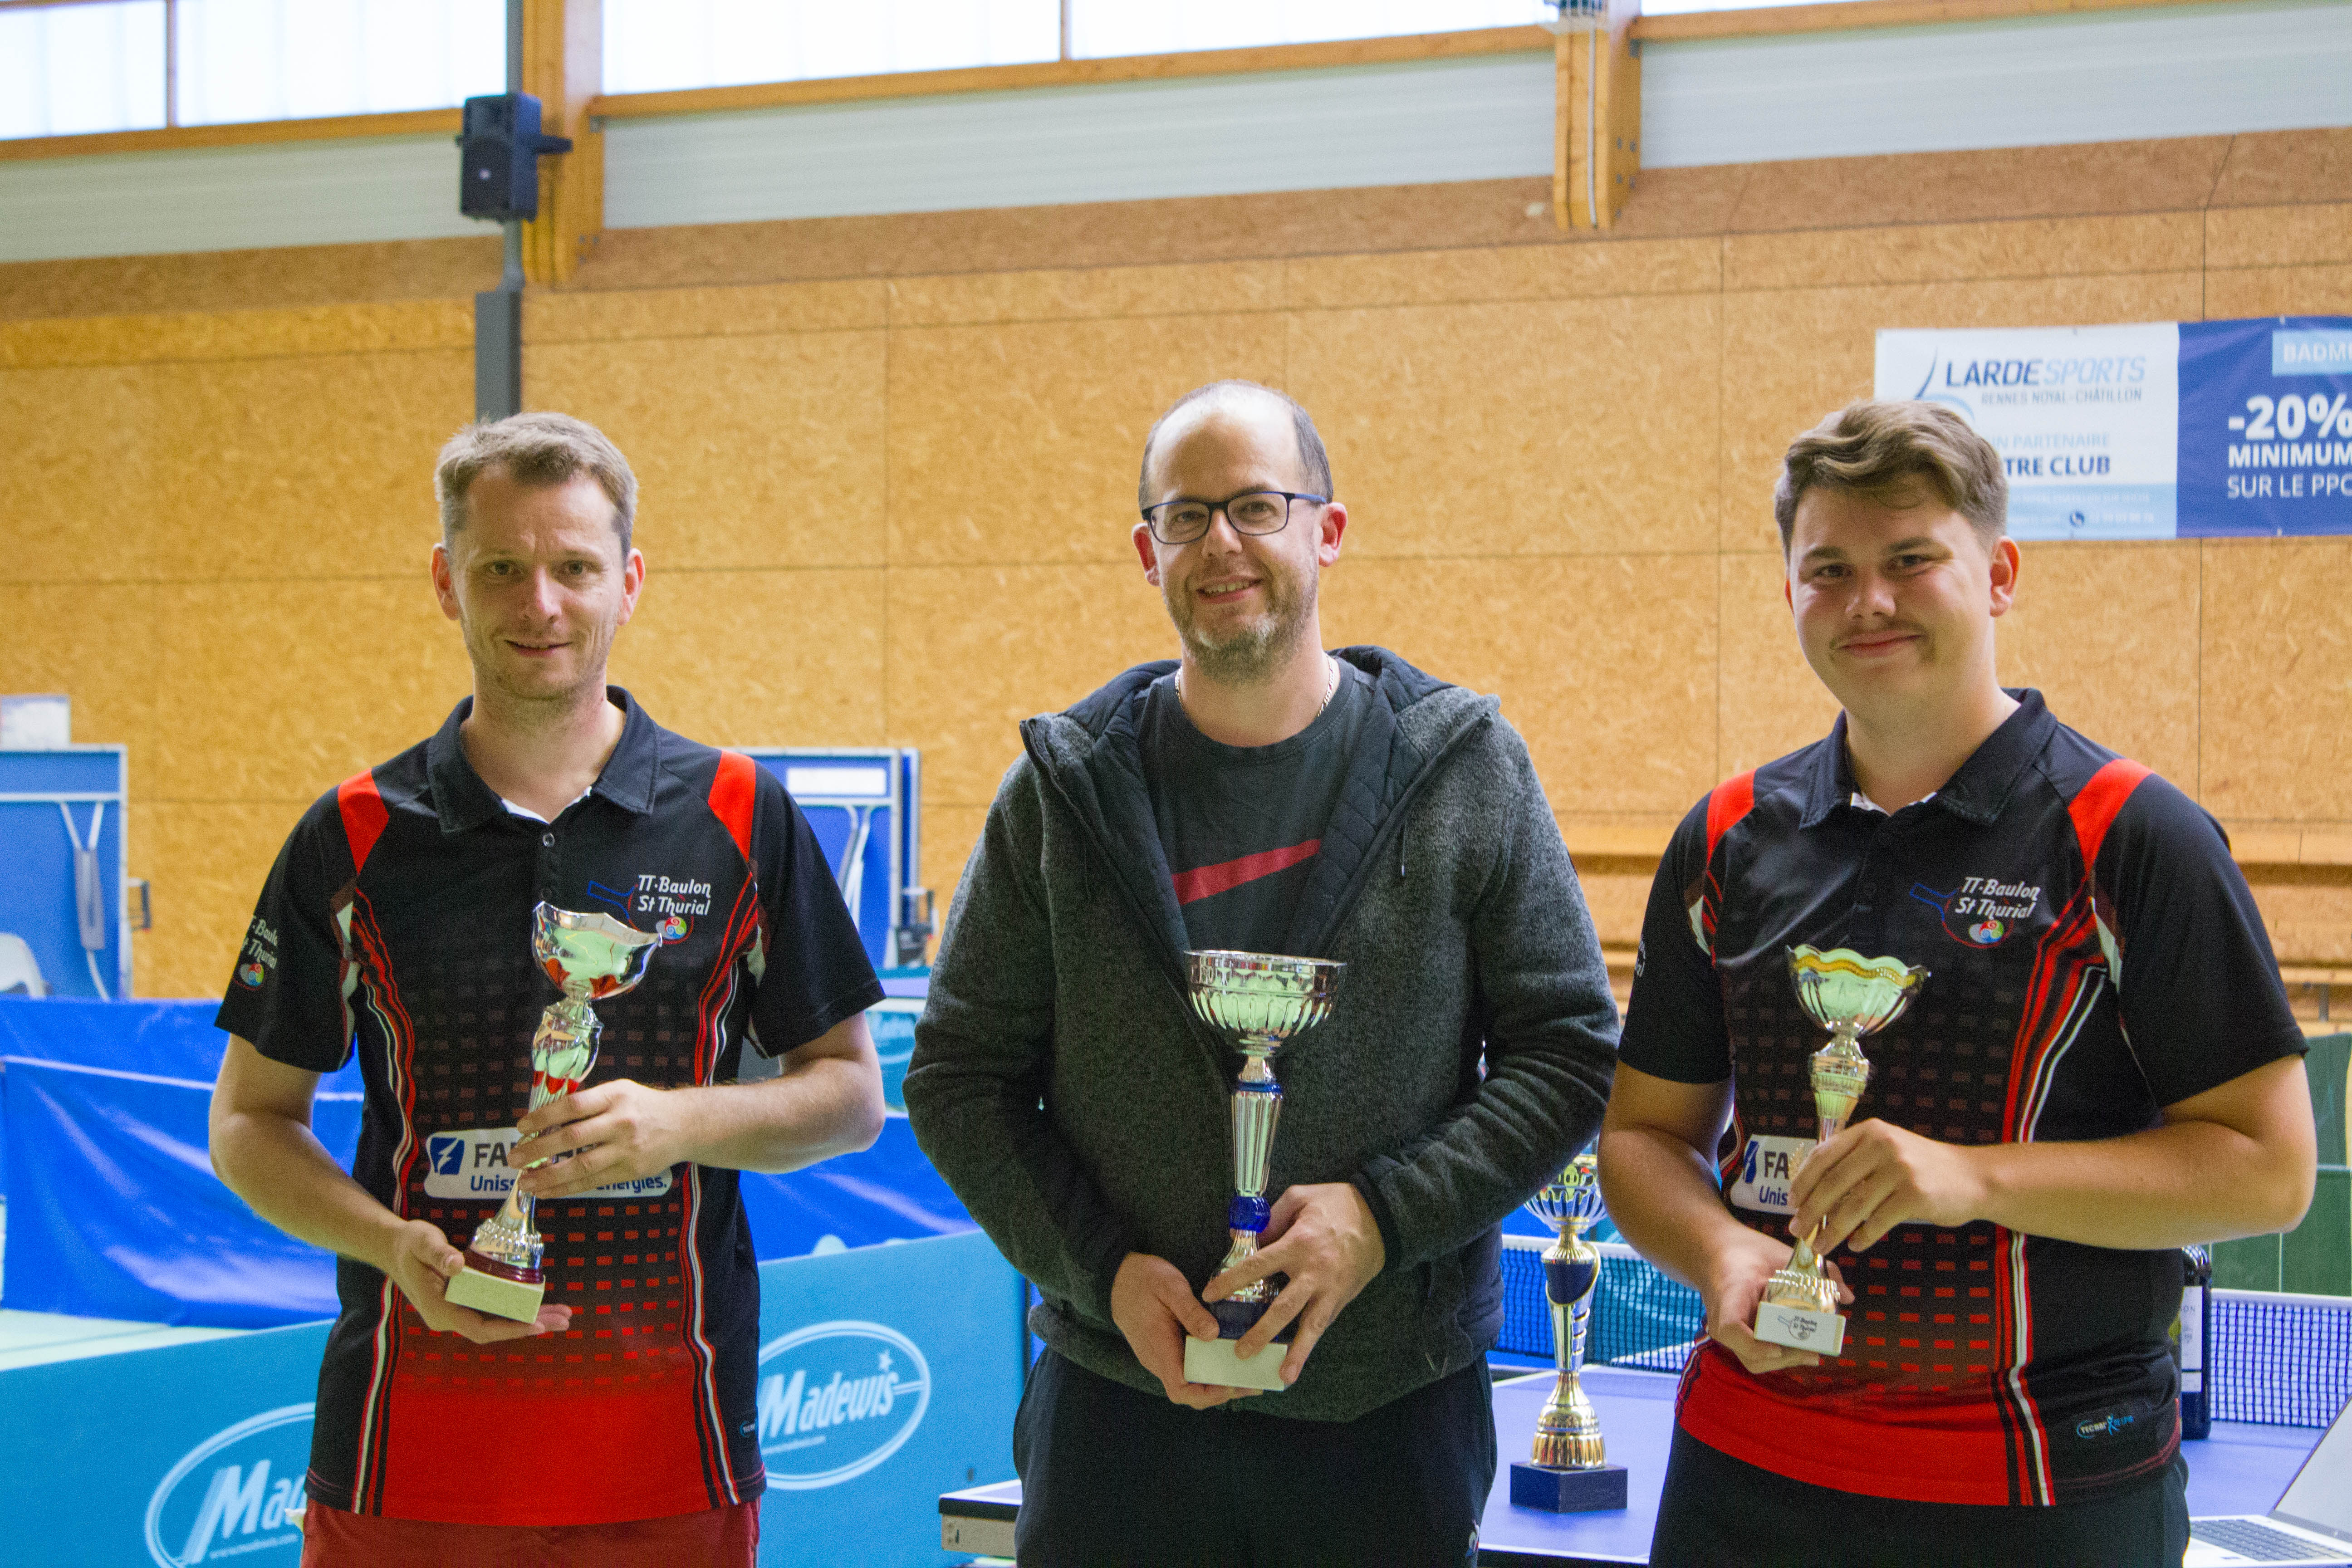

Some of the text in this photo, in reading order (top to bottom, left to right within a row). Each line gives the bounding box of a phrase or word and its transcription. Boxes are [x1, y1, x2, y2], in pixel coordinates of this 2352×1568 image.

[2229, 394, 2352, 440] -20%
[2013, 433, 2109, 449] PARTENAIRE
[2003, 455, 2110, 476] TRE CLUB
[2229, 442, 2352, 468] MINIMUM
[2228, 474, 2273, 499] SUR
[2279, 473, 2304, 498] LE
[638, 895, 711, 916] St Thurial
[1955, 897, 2037, 920] St Thurial
